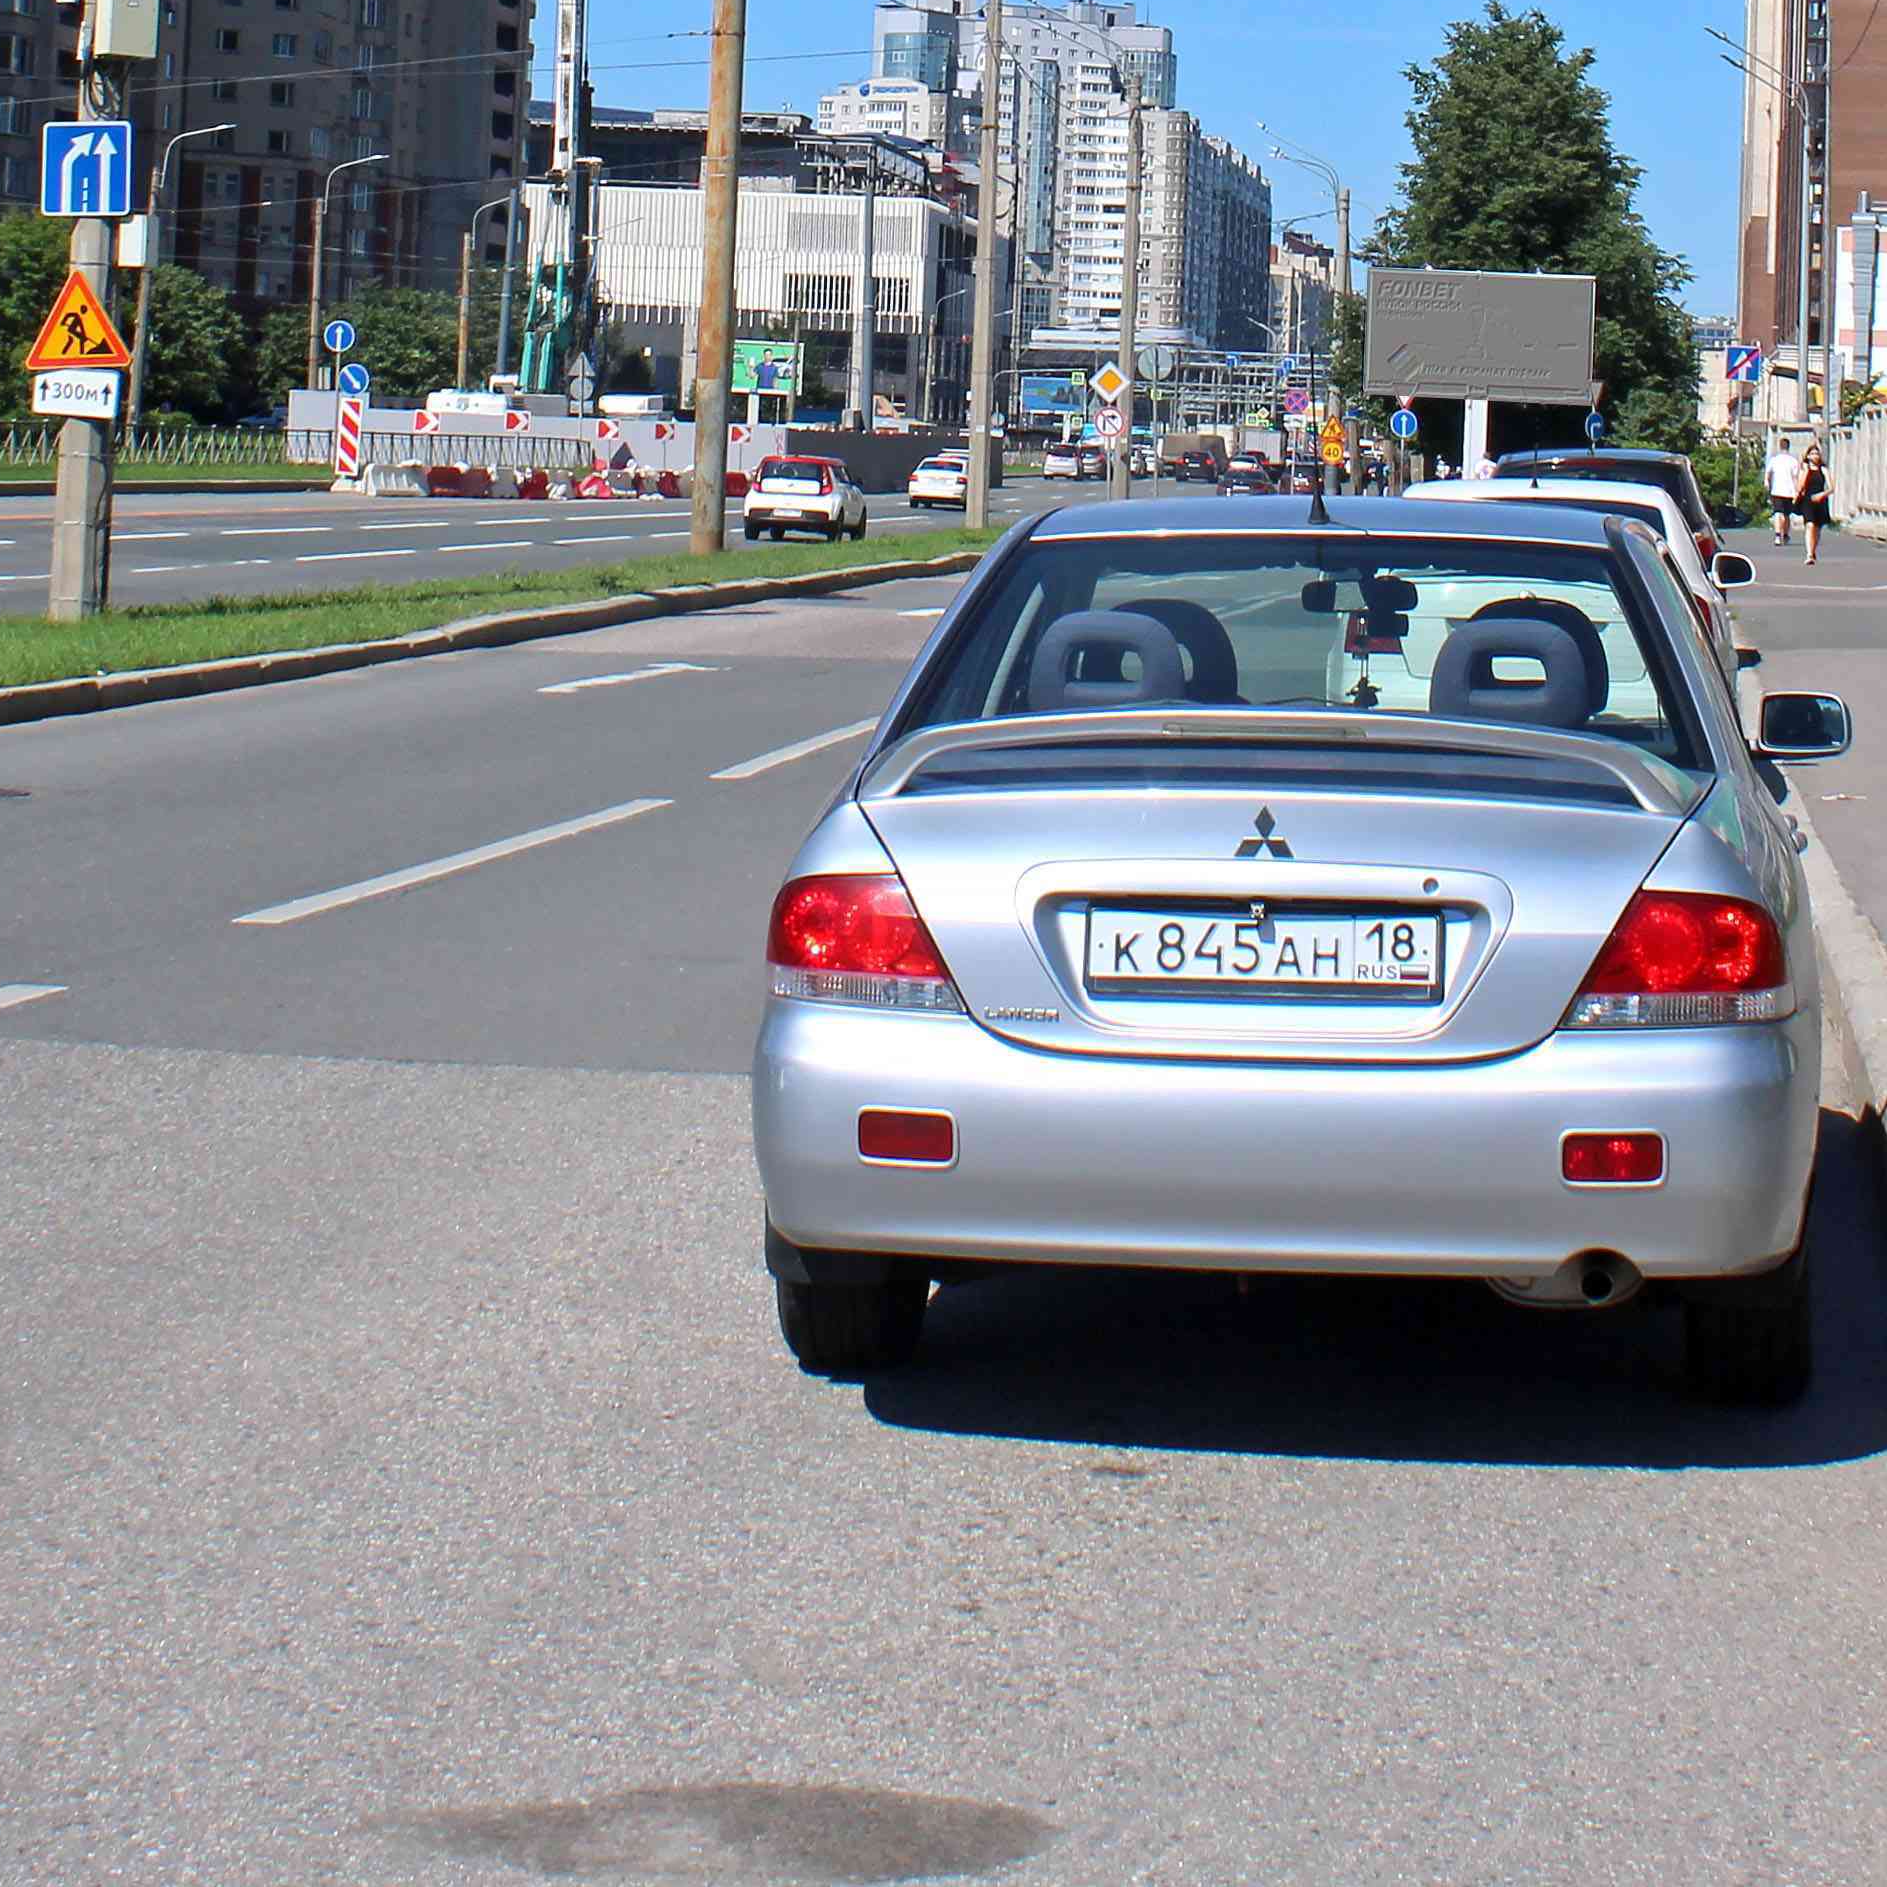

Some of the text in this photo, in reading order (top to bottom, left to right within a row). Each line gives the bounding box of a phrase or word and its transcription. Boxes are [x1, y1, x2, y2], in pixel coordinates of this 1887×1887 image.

[1377, 279, 1463, 300] FONBET
[1324, 447, 1339, 457] 40
[1365, 922, 1415, 962] 18
[1357, 964, 1397, 980] RUS
